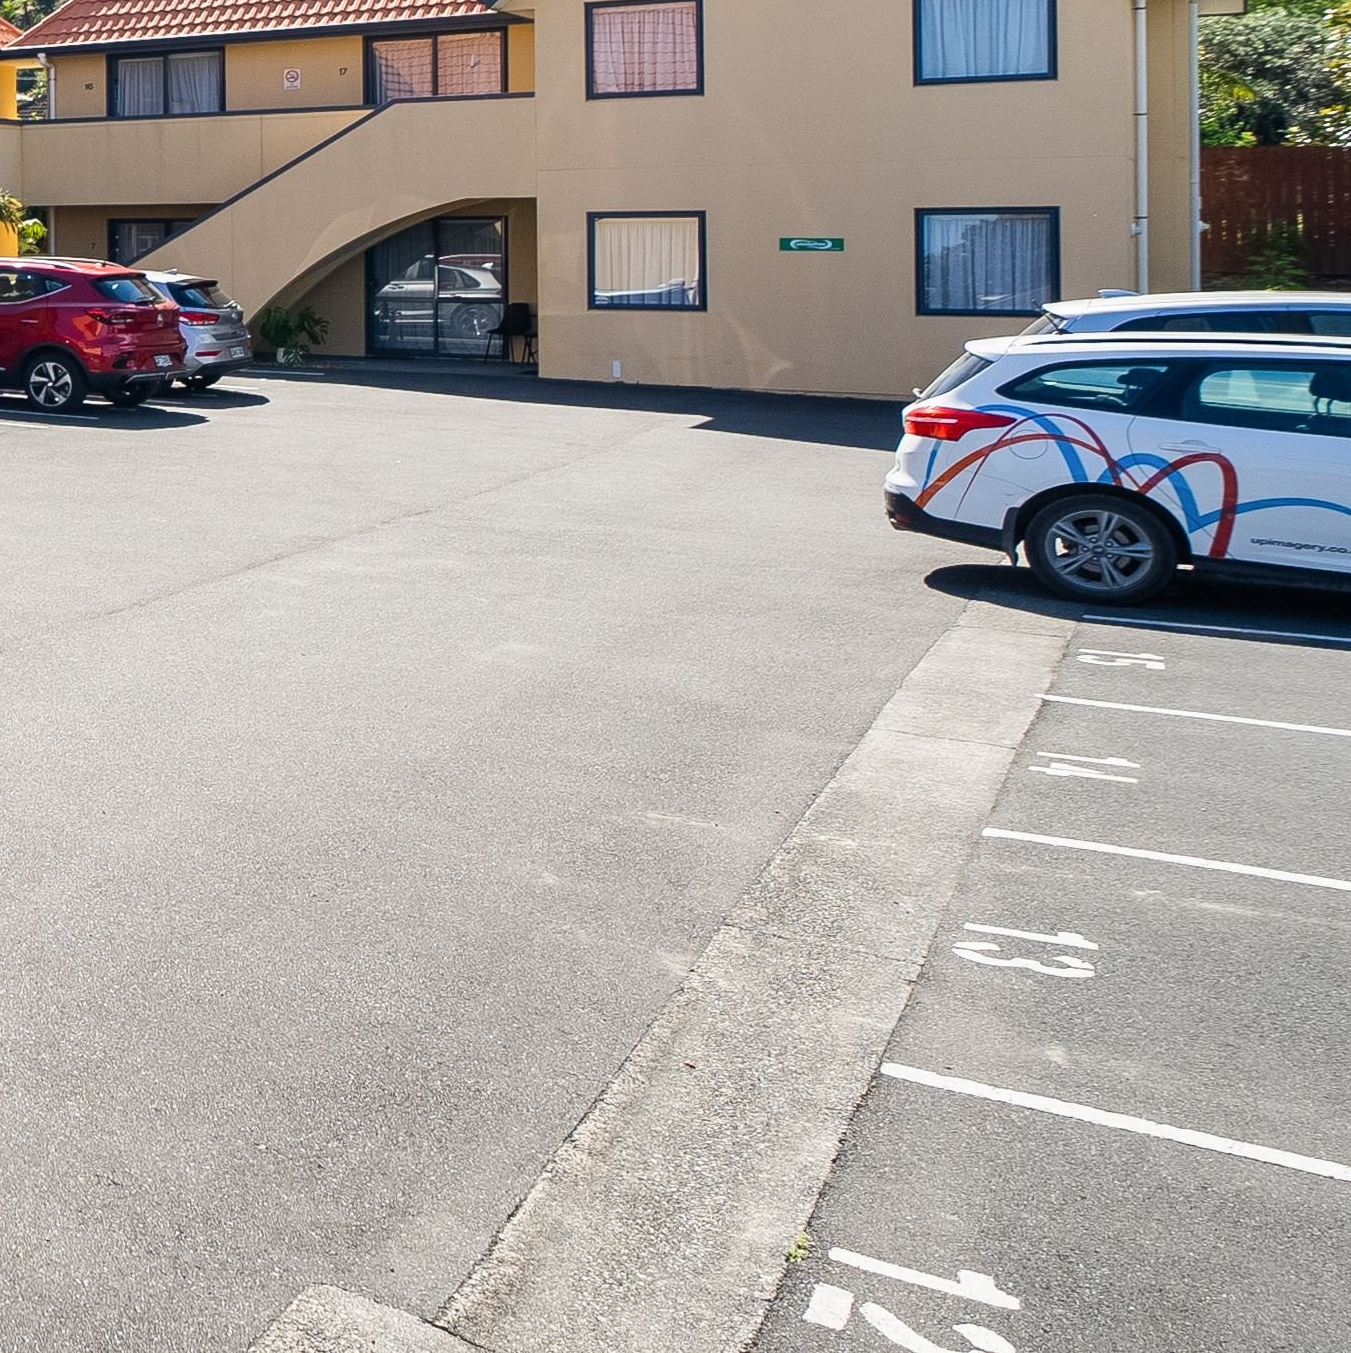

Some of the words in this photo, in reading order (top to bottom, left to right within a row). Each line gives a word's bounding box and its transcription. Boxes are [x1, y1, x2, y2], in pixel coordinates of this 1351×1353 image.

[339, 67, 348, 76] 17
[1076, 648, 1165, 670] 15
[1027, 751, 1141, 783] 14
[951, 922, 1099, 978] 13
[802, 1246, 1021, 1353] 12
